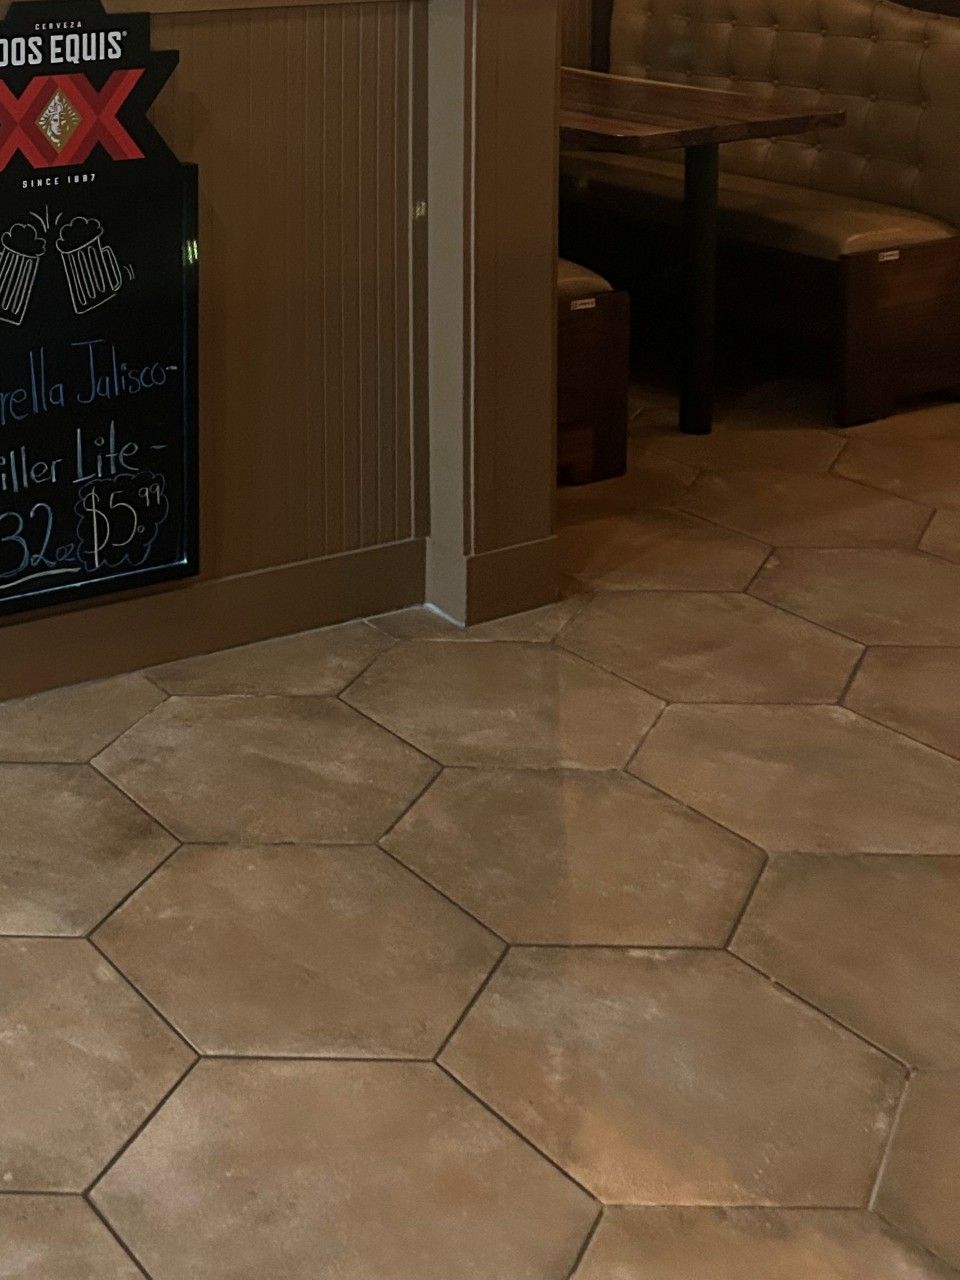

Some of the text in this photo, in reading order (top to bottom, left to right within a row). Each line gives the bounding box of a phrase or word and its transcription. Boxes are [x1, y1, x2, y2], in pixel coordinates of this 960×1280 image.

[34, 21, 82, 31] CERVEZA
[22, 173, 96, 189] SINCE 1897
